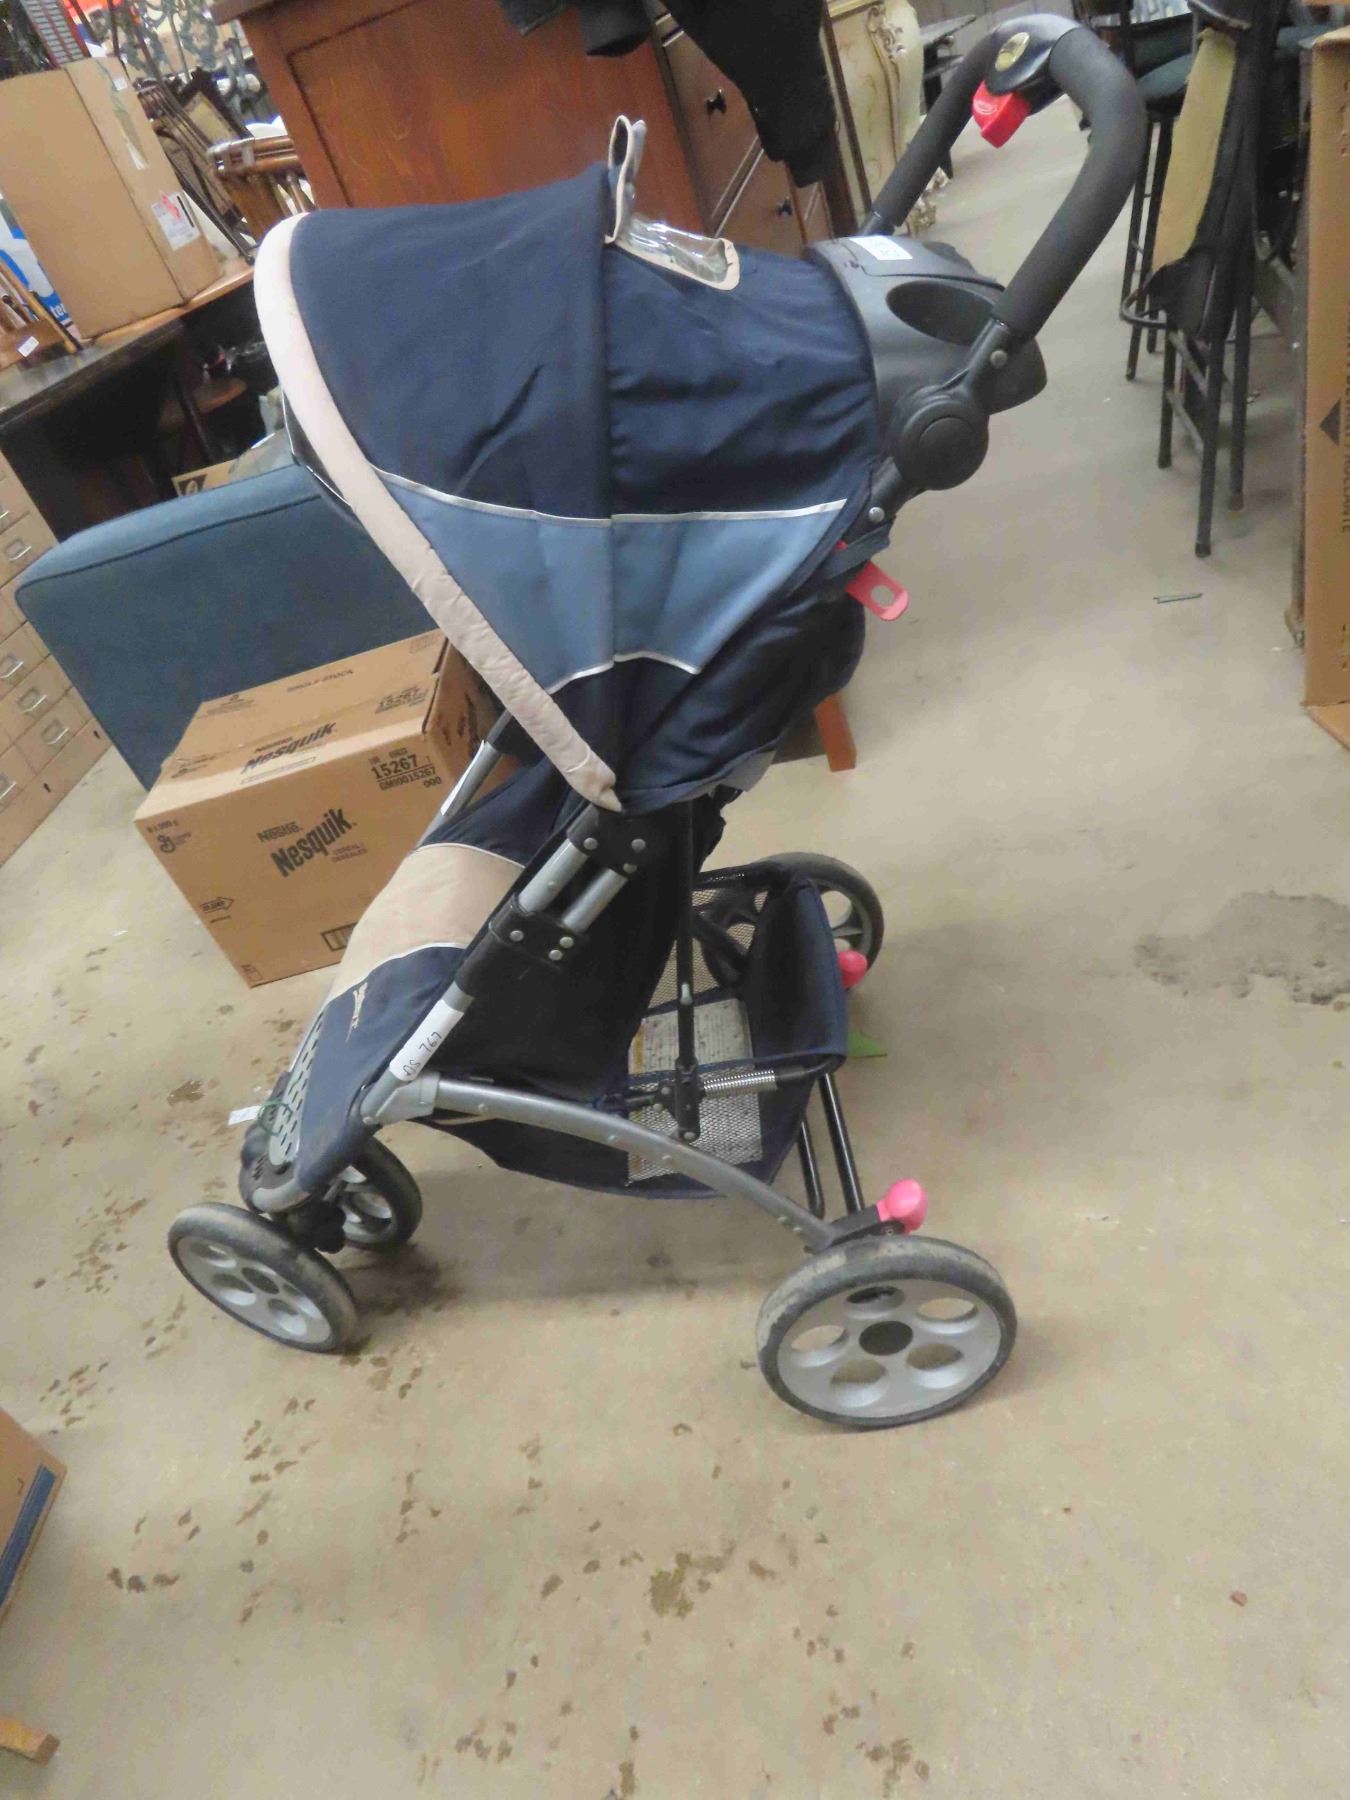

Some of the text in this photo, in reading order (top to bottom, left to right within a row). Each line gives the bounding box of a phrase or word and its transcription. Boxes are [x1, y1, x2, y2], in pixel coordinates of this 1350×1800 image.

[240, 722, 336, 774] Nesquik
[371, 753, 418, 779] 15267
[271, 808, 352, 878] Nesquik
